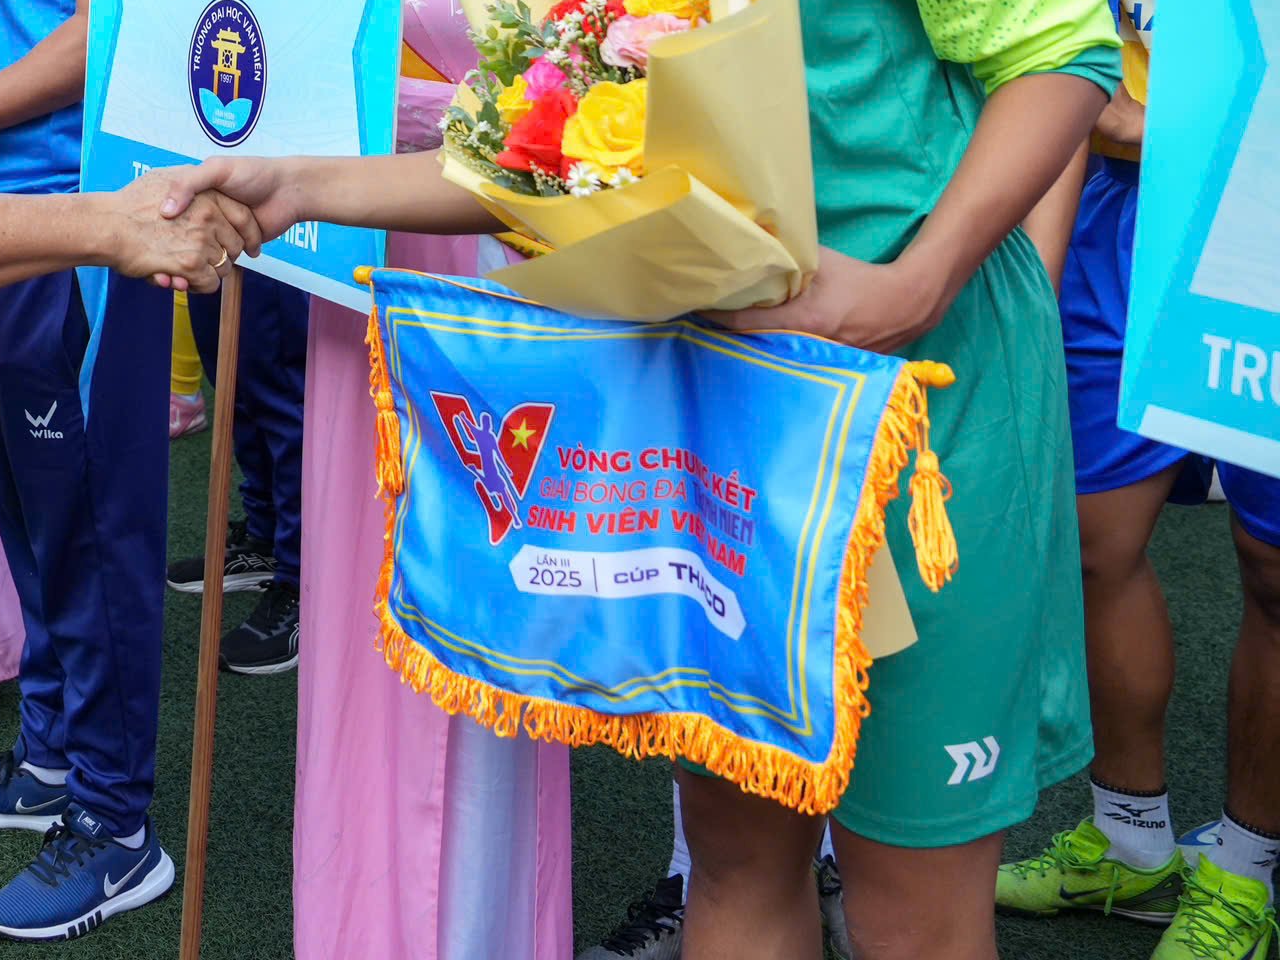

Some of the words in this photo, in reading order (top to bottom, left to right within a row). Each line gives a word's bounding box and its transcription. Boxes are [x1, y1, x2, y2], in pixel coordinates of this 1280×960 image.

[211, 6, 225, 24] ĐẠI
[226, 6, 243, 23] HỌC
[243, 16, 257, 45] VĂN
[220, 73, 233, 84] 1997
[29, 429, 64, 439] Wika
[557, 442, 632, 473] VÒNG
[711, 469, 757, 512] KẾT
[540, 475, 571, 500] GIẢI
[573, 478, 647, 504] BÓNG
[653, 477, 688, 501] ĐÁ
[527, 505, 577, 534] SINH
[586, 506, 660, 535] VIÊN
[707, 532, 748, 577] NAM
[536, 554, 558, 567] LẦN
[529, 566, 582, 587] 2025
[613, 566, 660, 584] CÚP
